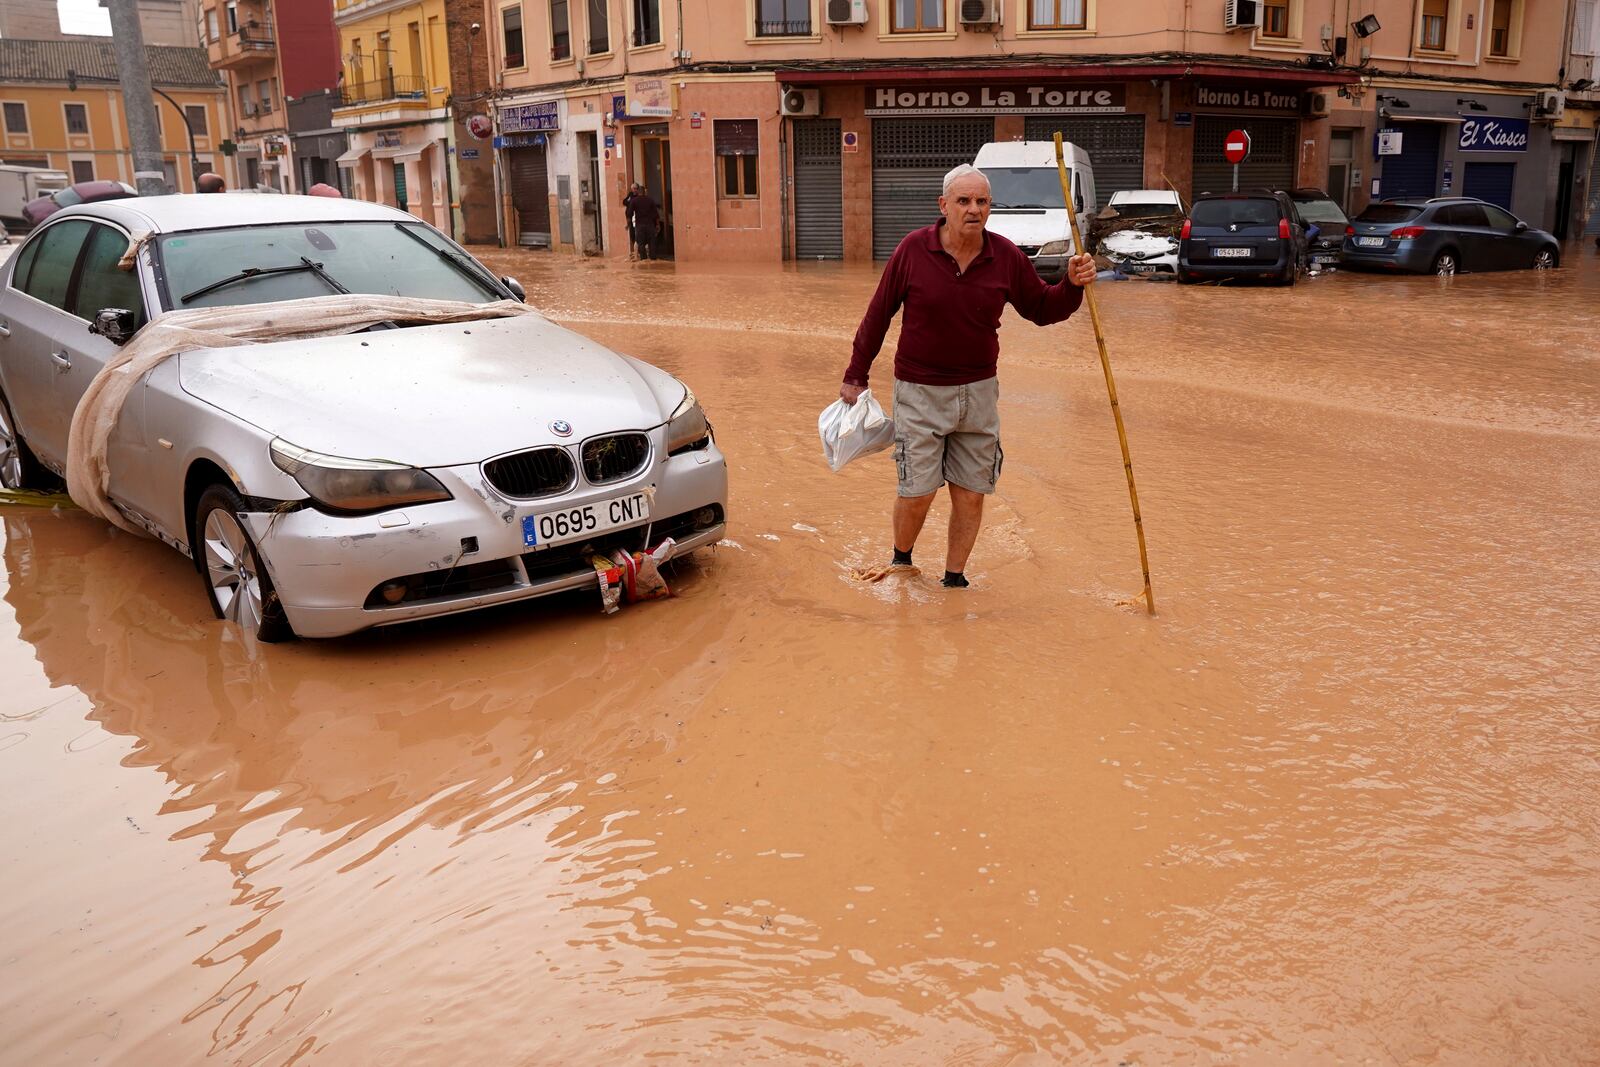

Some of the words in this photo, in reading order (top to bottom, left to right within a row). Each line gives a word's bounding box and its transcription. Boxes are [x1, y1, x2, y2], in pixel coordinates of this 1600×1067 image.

[875, 88, 970, 107] Horno
[981, 87, 1016, 106] La
[1027, 87, 1112, 106] Torre
[1198, 88, 1240, 105] Horno
[1244, 90, 1259, 106] La
[1264, 91, 1297, 108] Torre
[521, 117, 540, 129] ALTO
[540, 115, 558, 129] TAJO
[1460, 120, 1480, 147] El
[1483, 121, 1527, 146] Kiosco
[527, 534, 533, 542] E
[540, 506, 597, 539] 0695
[609, 495, 643, 524] CNT
